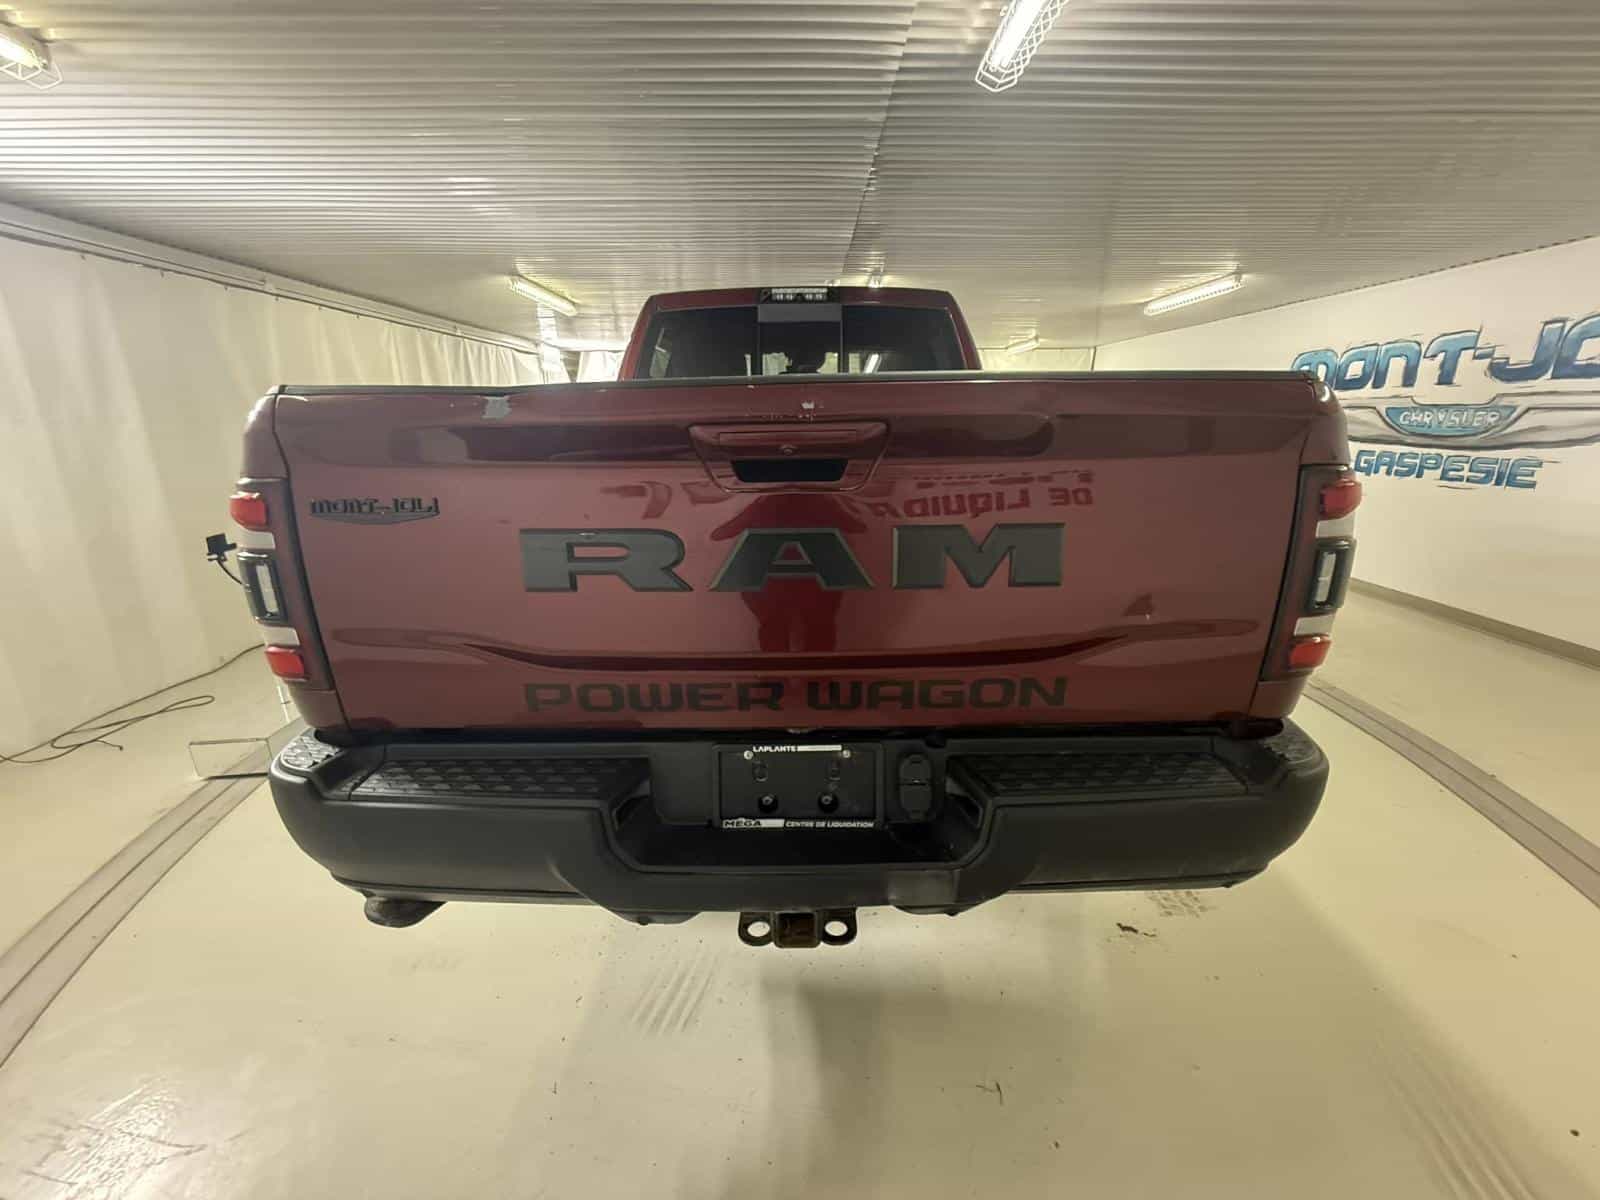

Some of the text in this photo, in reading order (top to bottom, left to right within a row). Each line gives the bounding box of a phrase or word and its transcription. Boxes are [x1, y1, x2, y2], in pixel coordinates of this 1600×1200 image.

[1400, 408, 1500, 427] CHRYSLER
[1354, 450, 1543, 489] GASPESIE
[519, 522, 1066, 593] RAM
[523, 676, 1068, 713] POWER WAGON
